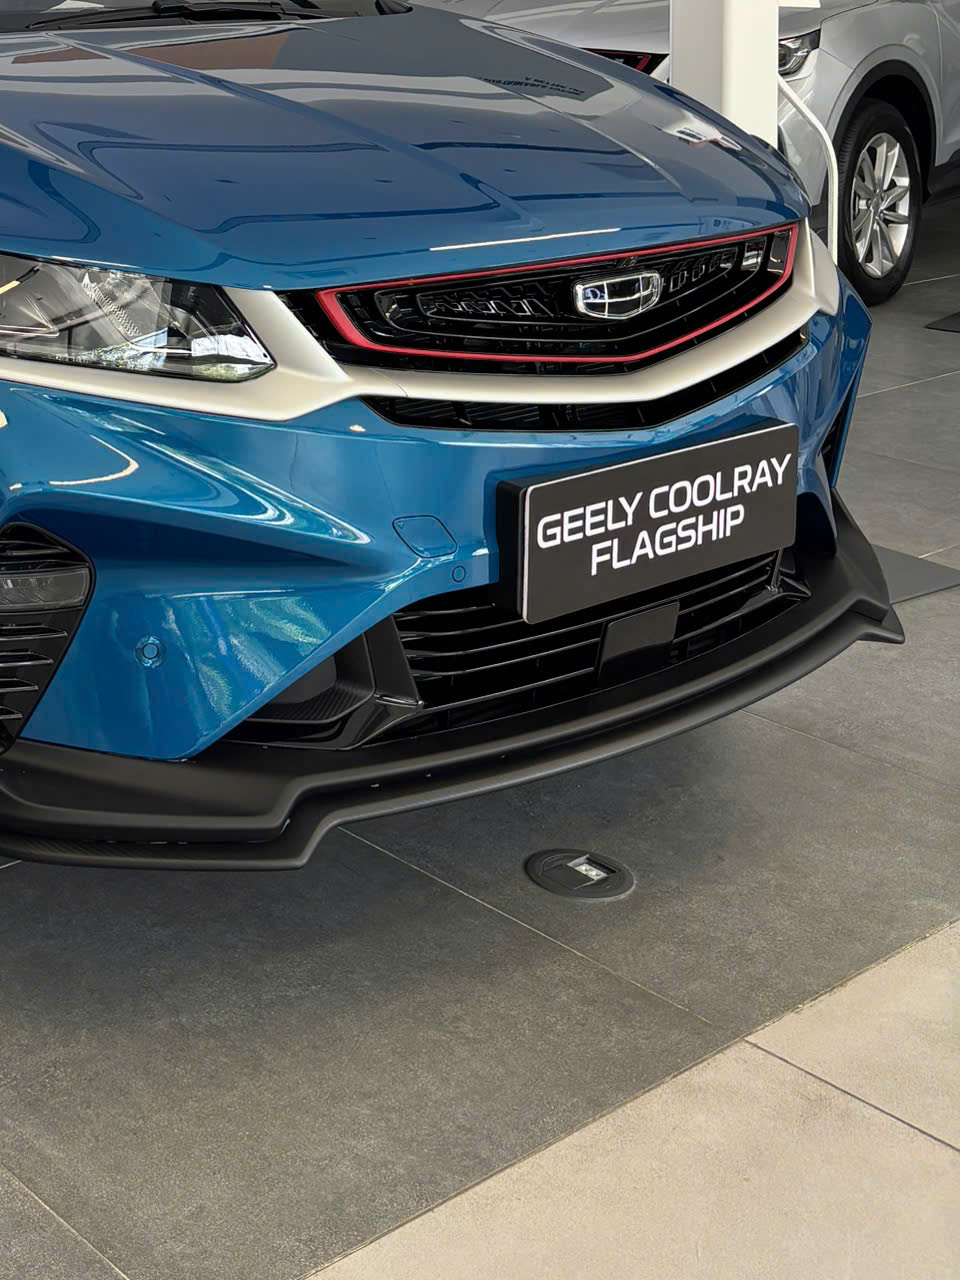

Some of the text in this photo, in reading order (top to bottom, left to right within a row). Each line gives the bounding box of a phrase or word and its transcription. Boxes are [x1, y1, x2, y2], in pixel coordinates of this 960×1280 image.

[536, 453, 792, 549] GEELY COOLRAY
[590, 504, 745, 576] FLAGSHIP
